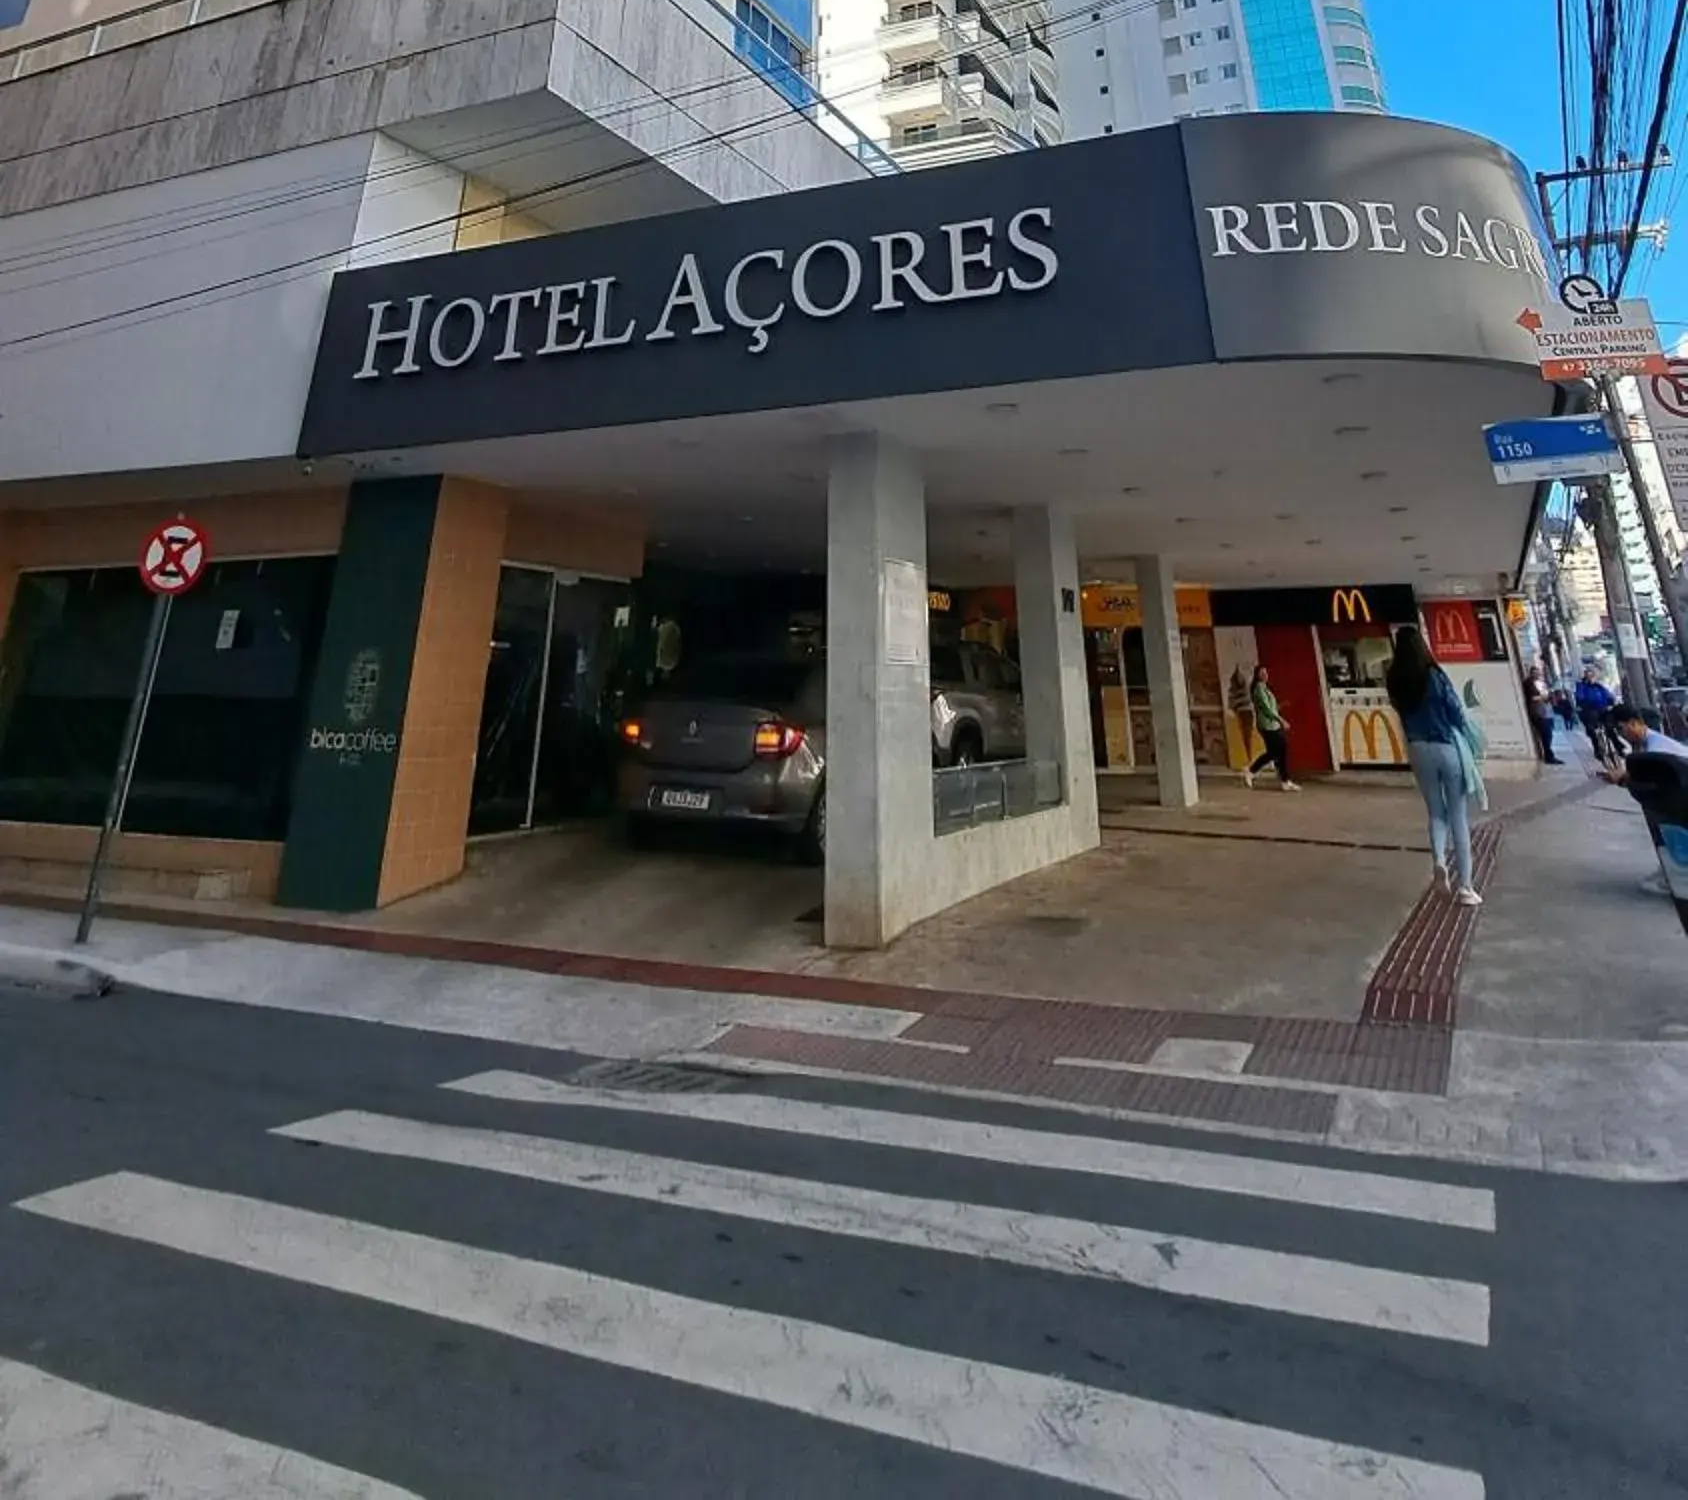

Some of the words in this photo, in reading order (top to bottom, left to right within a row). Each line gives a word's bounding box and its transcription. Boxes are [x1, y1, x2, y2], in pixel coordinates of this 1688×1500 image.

[1205, 200, 1406, 258] REDE
[352, 275, 637, 381] HOTEL
[645, 206, 1060, 353] AÇORES
[1573, 315, 1623, 327] ABERTO
[1536, 328, 1655, 347] ESTACIONAMENTO
[1496, 441, 1533, 460] 1150
